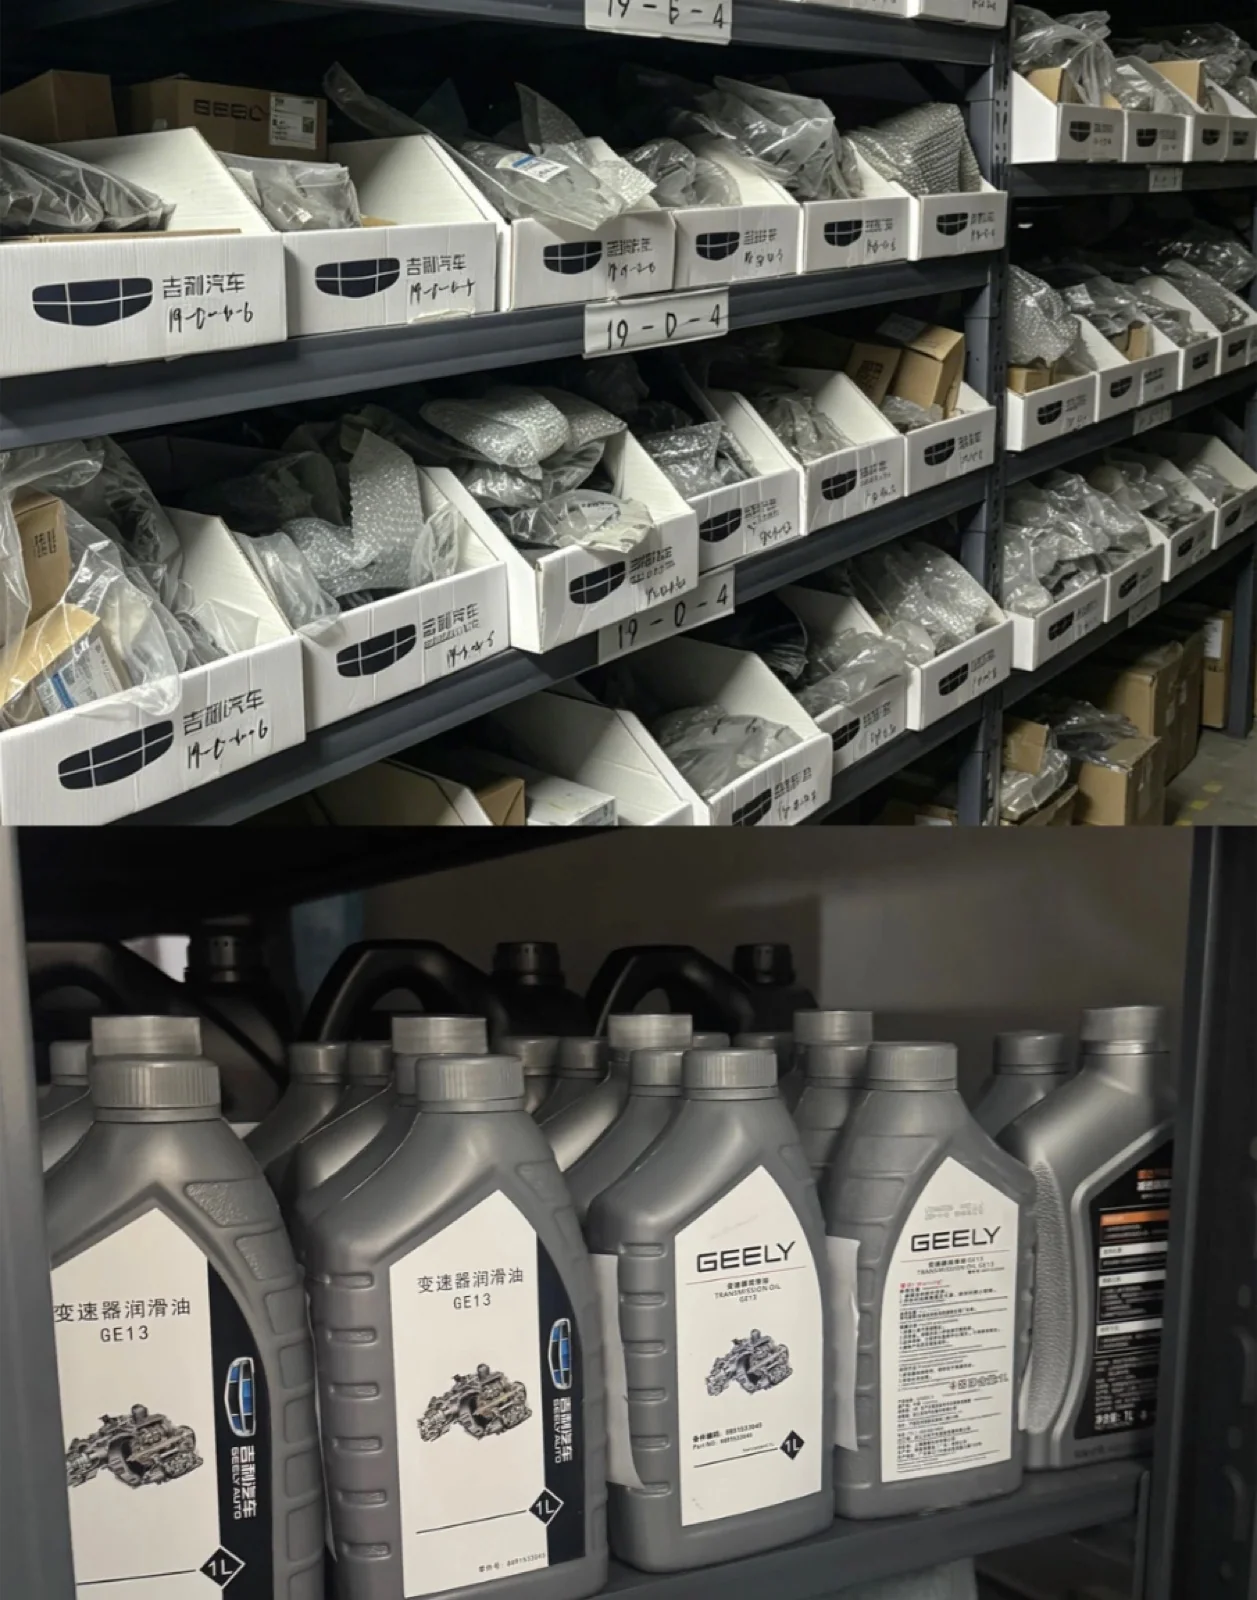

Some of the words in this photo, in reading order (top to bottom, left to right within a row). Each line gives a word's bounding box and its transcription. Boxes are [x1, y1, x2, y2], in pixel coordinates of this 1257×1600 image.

[910, 1225, 1001, 1252] GEELY
[696, 1240, 796, 1273] GEELY
[417, 1267, 524, 1293] 变速器润滑油
[54, 1297, 191, 1323] 变速器润滑油
[453, 1293, 491, 1310] GE13
[99, 1325, 149, 1343] GE13
[785, 1438, 800, 1453] 1L
[233, 1487, 241, 1520] AUTO
[536, 1499, 554, 1515] 1L
[208, 1558, 233, 1576] 1L
